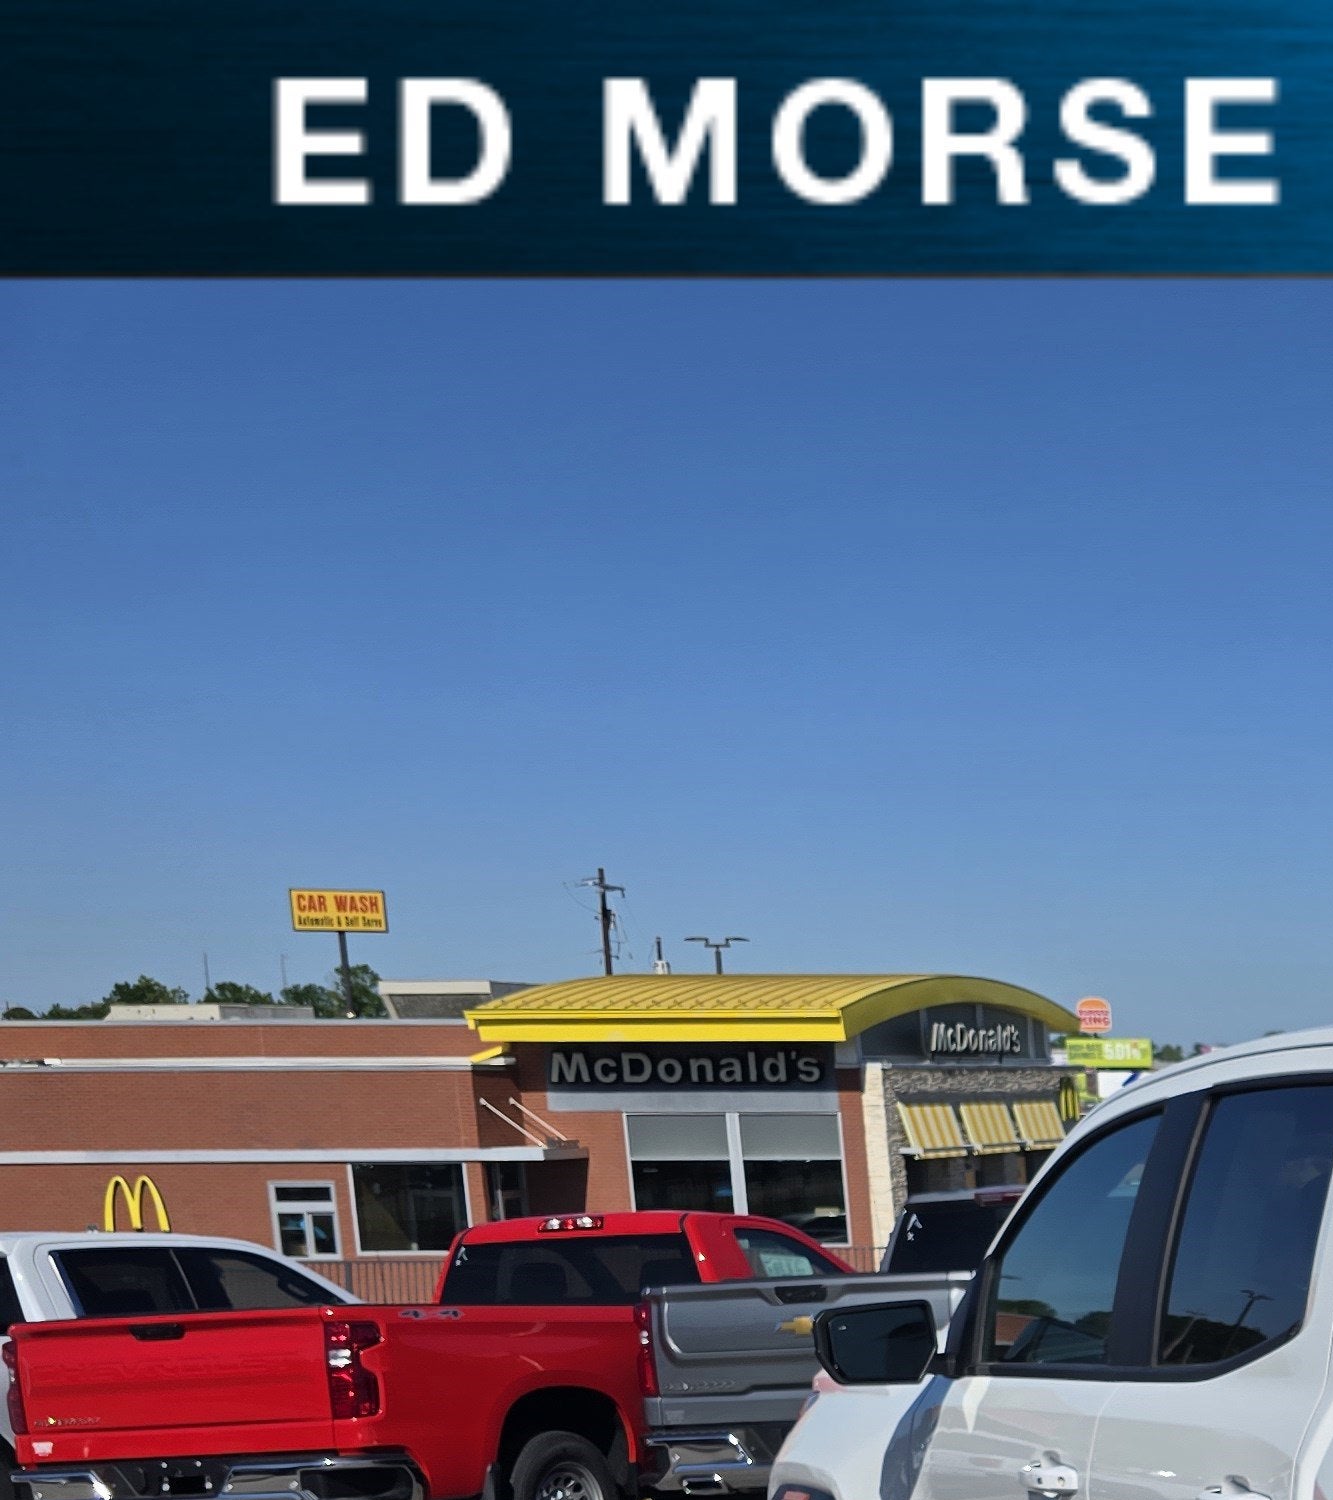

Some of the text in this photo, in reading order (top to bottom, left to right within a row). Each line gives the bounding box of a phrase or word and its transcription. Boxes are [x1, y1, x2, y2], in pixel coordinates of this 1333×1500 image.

[297, 895, 380, 914] CAR WASH
[930, 1022, 1021, 1053] McDonald's
[551, 1050, 821, 1083] McDonald's
